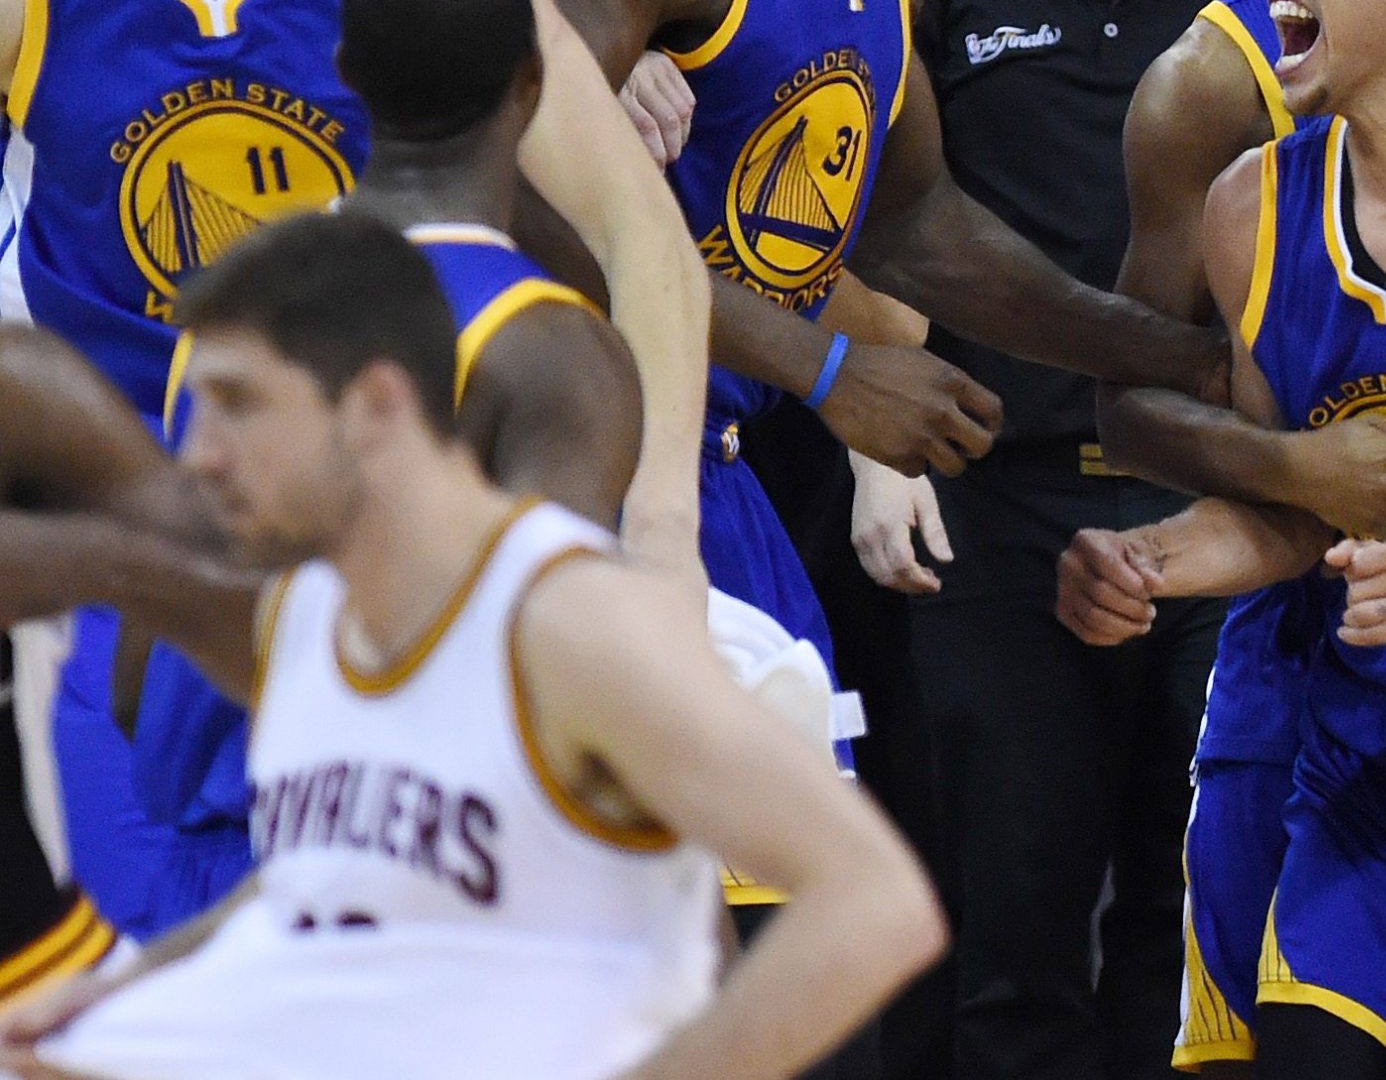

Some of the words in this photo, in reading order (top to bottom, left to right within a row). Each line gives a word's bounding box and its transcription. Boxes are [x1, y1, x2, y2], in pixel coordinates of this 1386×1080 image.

[110, 78, 234, 163] GOLDEN
[246, 83, 345, 143] STATE
[245, 146, 290, 195] 11
[822, 126, 862, 182] 31
